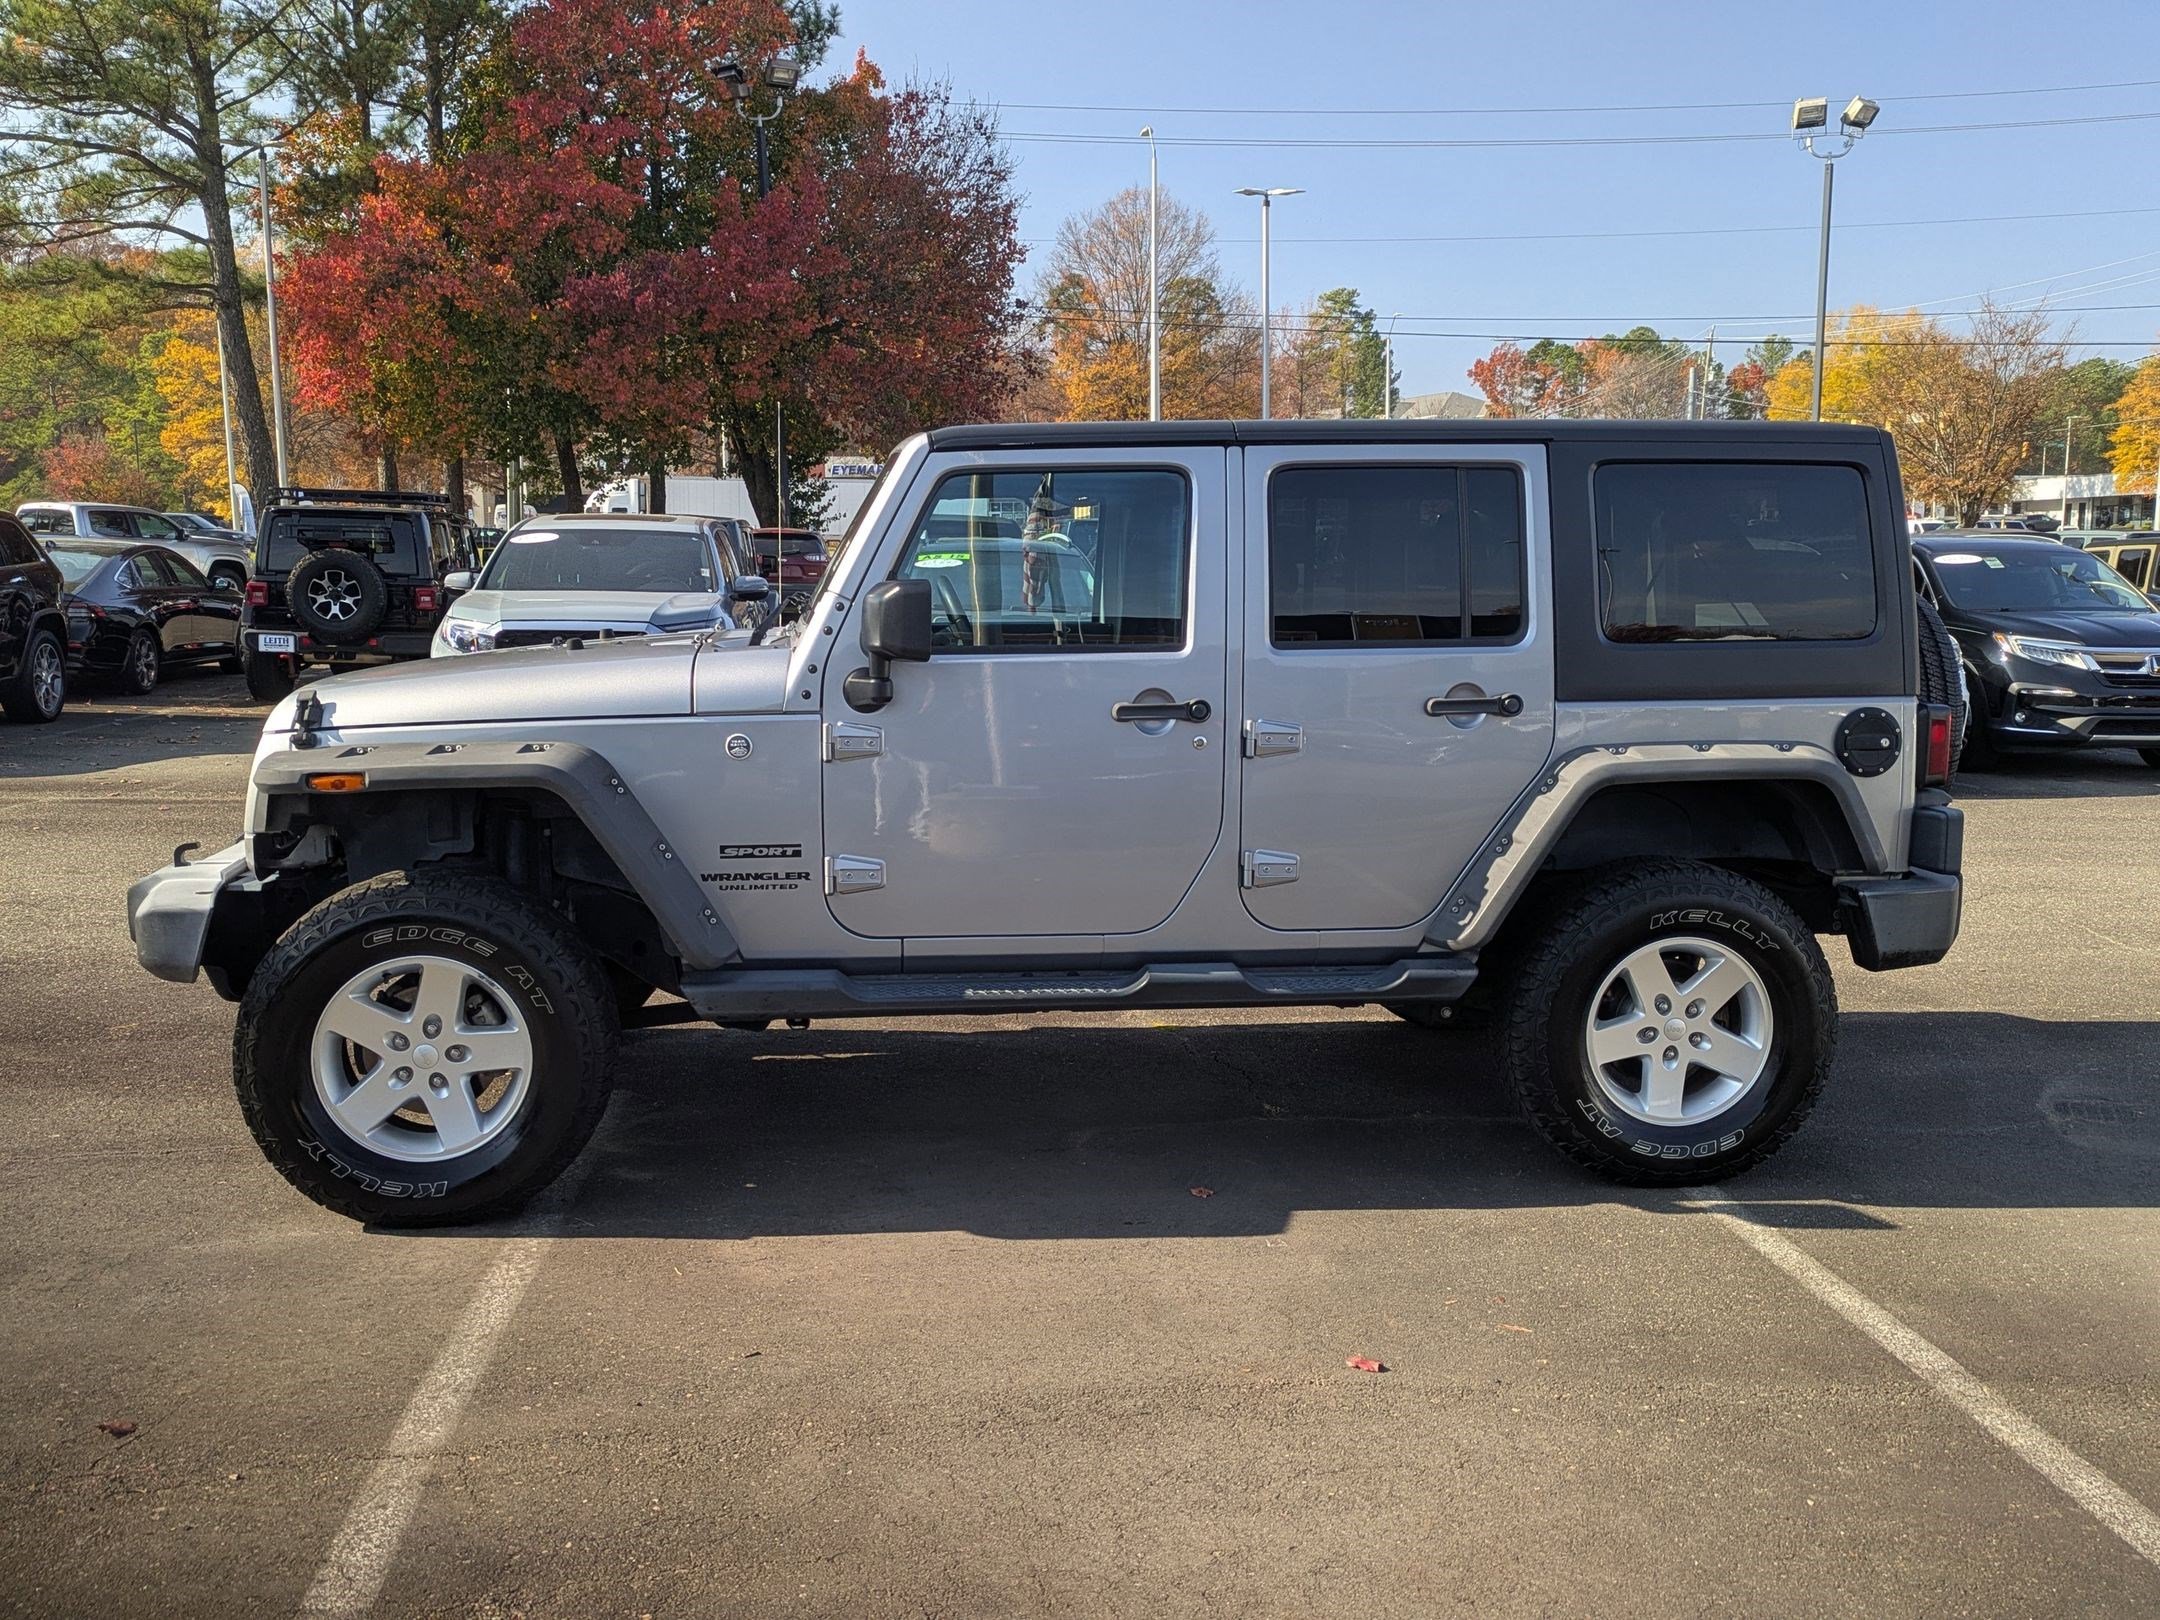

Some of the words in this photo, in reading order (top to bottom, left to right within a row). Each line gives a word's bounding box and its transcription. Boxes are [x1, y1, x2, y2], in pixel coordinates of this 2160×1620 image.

[263, 636, 289, 644] LEITH
[723, 846, 801, 857] SPORT
[700, 871, 811, 882] WRANGLER
[719, 883, 799, 891] UNLIMITED
[1650, 909, 1781, 950] KELLY
[362, 925, 499, 957] EDGE
[504, 965, 555, 1015] AT
[1576, 1099, 1624, 1139] AT
[1630, 1128, 1745, 1159] EDGE
[297, 1138, 448, 1199] KELLY
